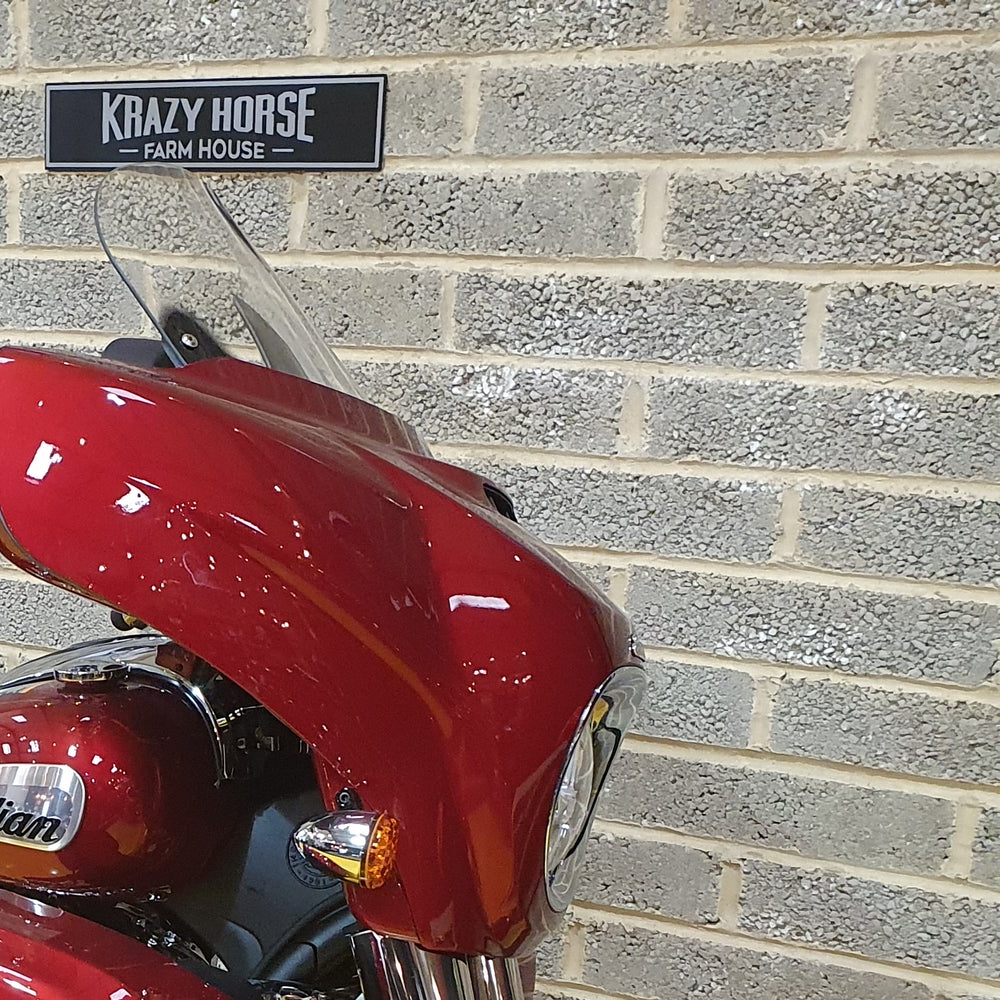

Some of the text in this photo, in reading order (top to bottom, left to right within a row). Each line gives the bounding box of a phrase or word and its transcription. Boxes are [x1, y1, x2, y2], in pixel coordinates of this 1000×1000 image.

[102, 87, 317, 144] KRAZY HORSE
[144, 139, 265, 160] FARM HOUSE
